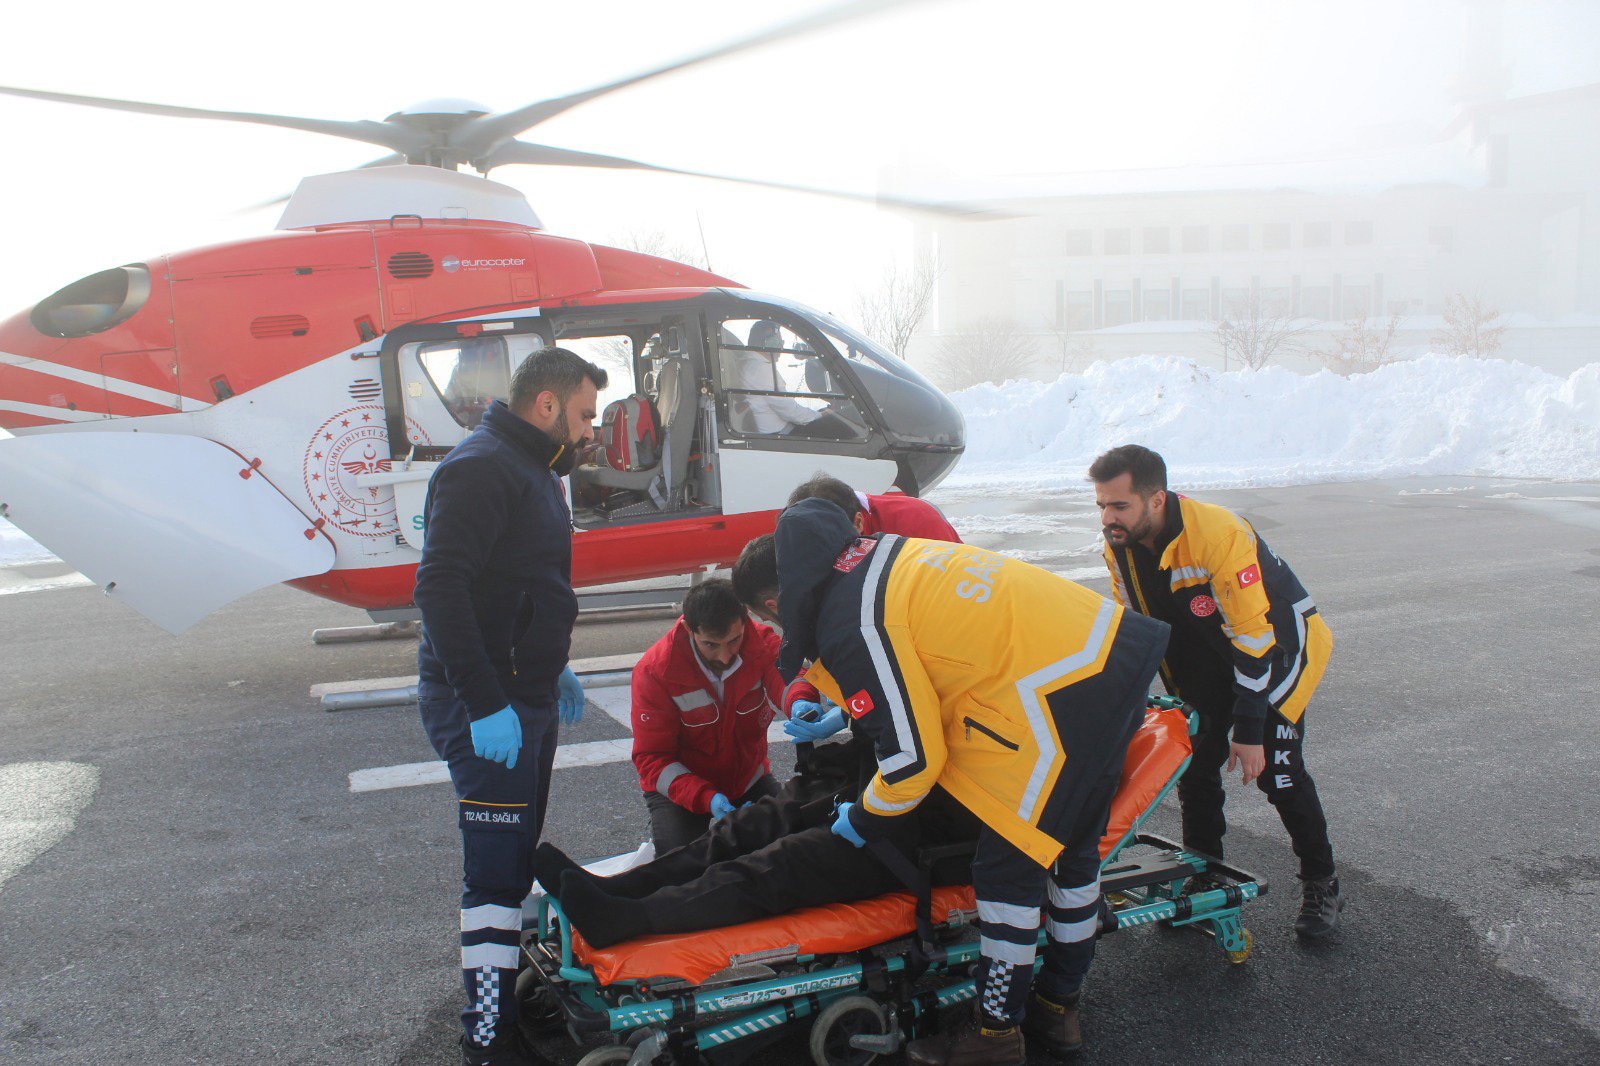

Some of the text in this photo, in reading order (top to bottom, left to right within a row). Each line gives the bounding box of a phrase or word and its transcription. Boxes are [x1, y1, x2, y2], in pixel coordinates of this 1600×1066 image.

[461, 258, 525, 267] eurocopter
[329, 429, 376, 473] CUMHURİYETİ
[464, 810, 521, 823] 112 ACİL SAĞLIK
[793, 977, 846, 995] TARGET
